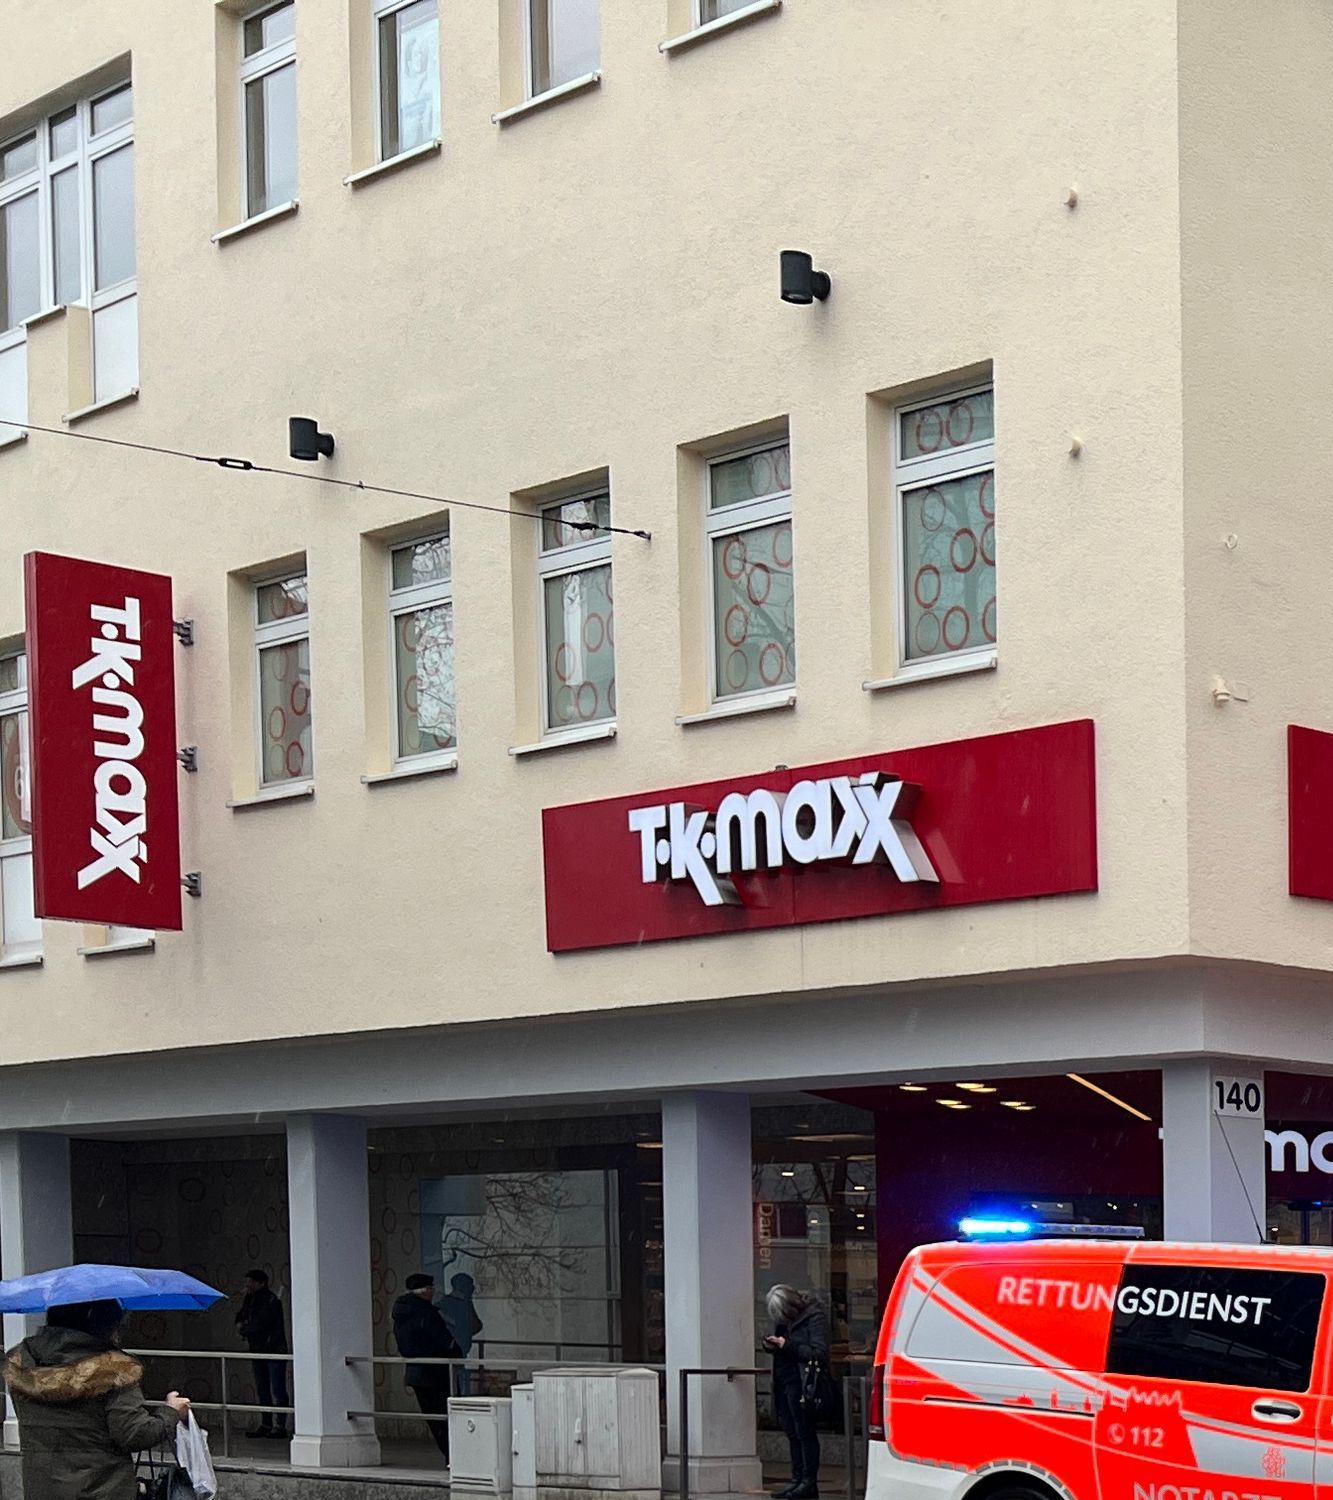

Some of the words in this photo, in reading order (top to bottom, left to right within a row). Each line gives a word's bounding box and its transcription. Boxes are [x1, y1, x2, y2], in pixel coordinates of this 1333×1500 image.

[1215, 1078, 1261, 1112] 140
[997, 1276, 1272, 1325] RETTUNGSDIENST
[1130, 1426, 1164, 1448] 112
